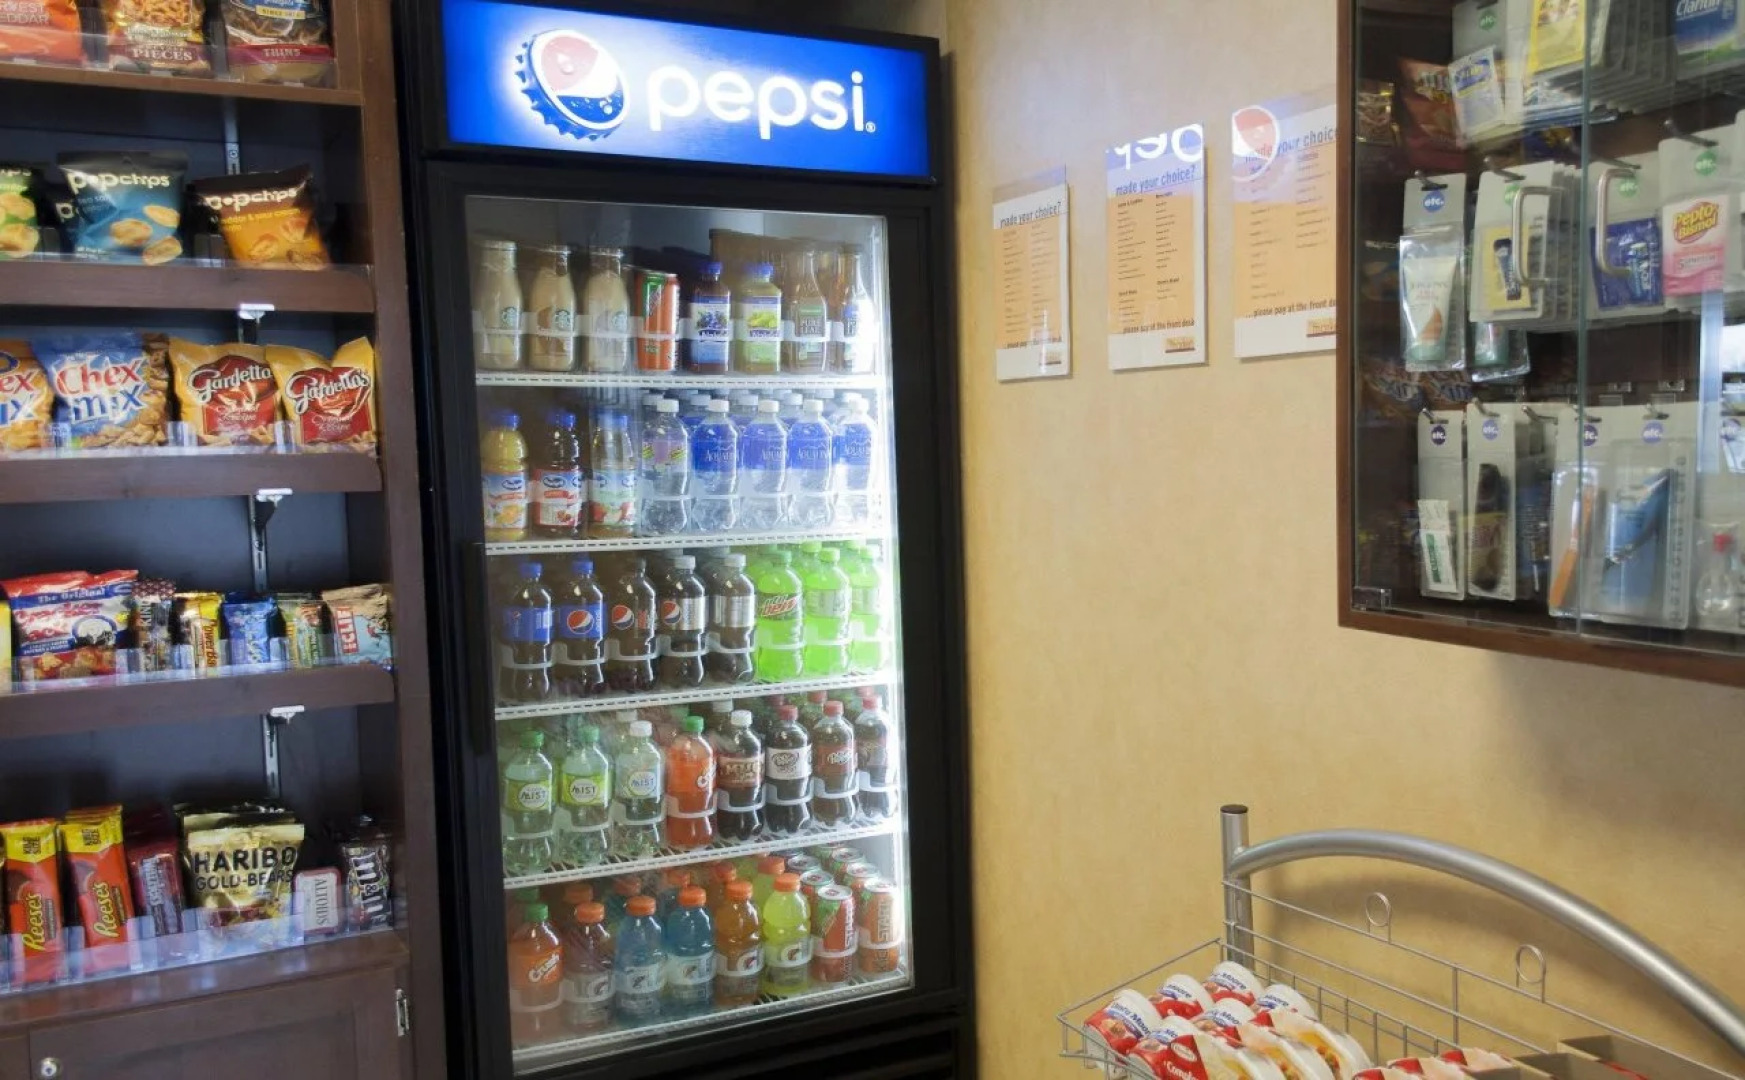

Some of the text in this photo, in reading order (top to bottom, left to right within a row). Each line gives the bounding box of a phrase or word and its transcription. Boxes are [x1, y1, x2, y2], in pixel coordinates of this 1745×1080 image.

[132, 48, 193, 61] PIECES
[646, 65, 866, 139] pepsi
[1161, 164, 1195, 185] choice?
[1679, 214, 1717, 240] Bismol
[0, 370, 36, 394] ex
[56, 358, 144, 395] Chex
[188, 365, 273, 405] Gardetto
[195, 847, 295, 873] HARIBO
[196, 870, 294, 891] GOLD-BEARS
[94, 881, 120, 937] Reese's
[315, 879, 328, 925] ALTOIDS
